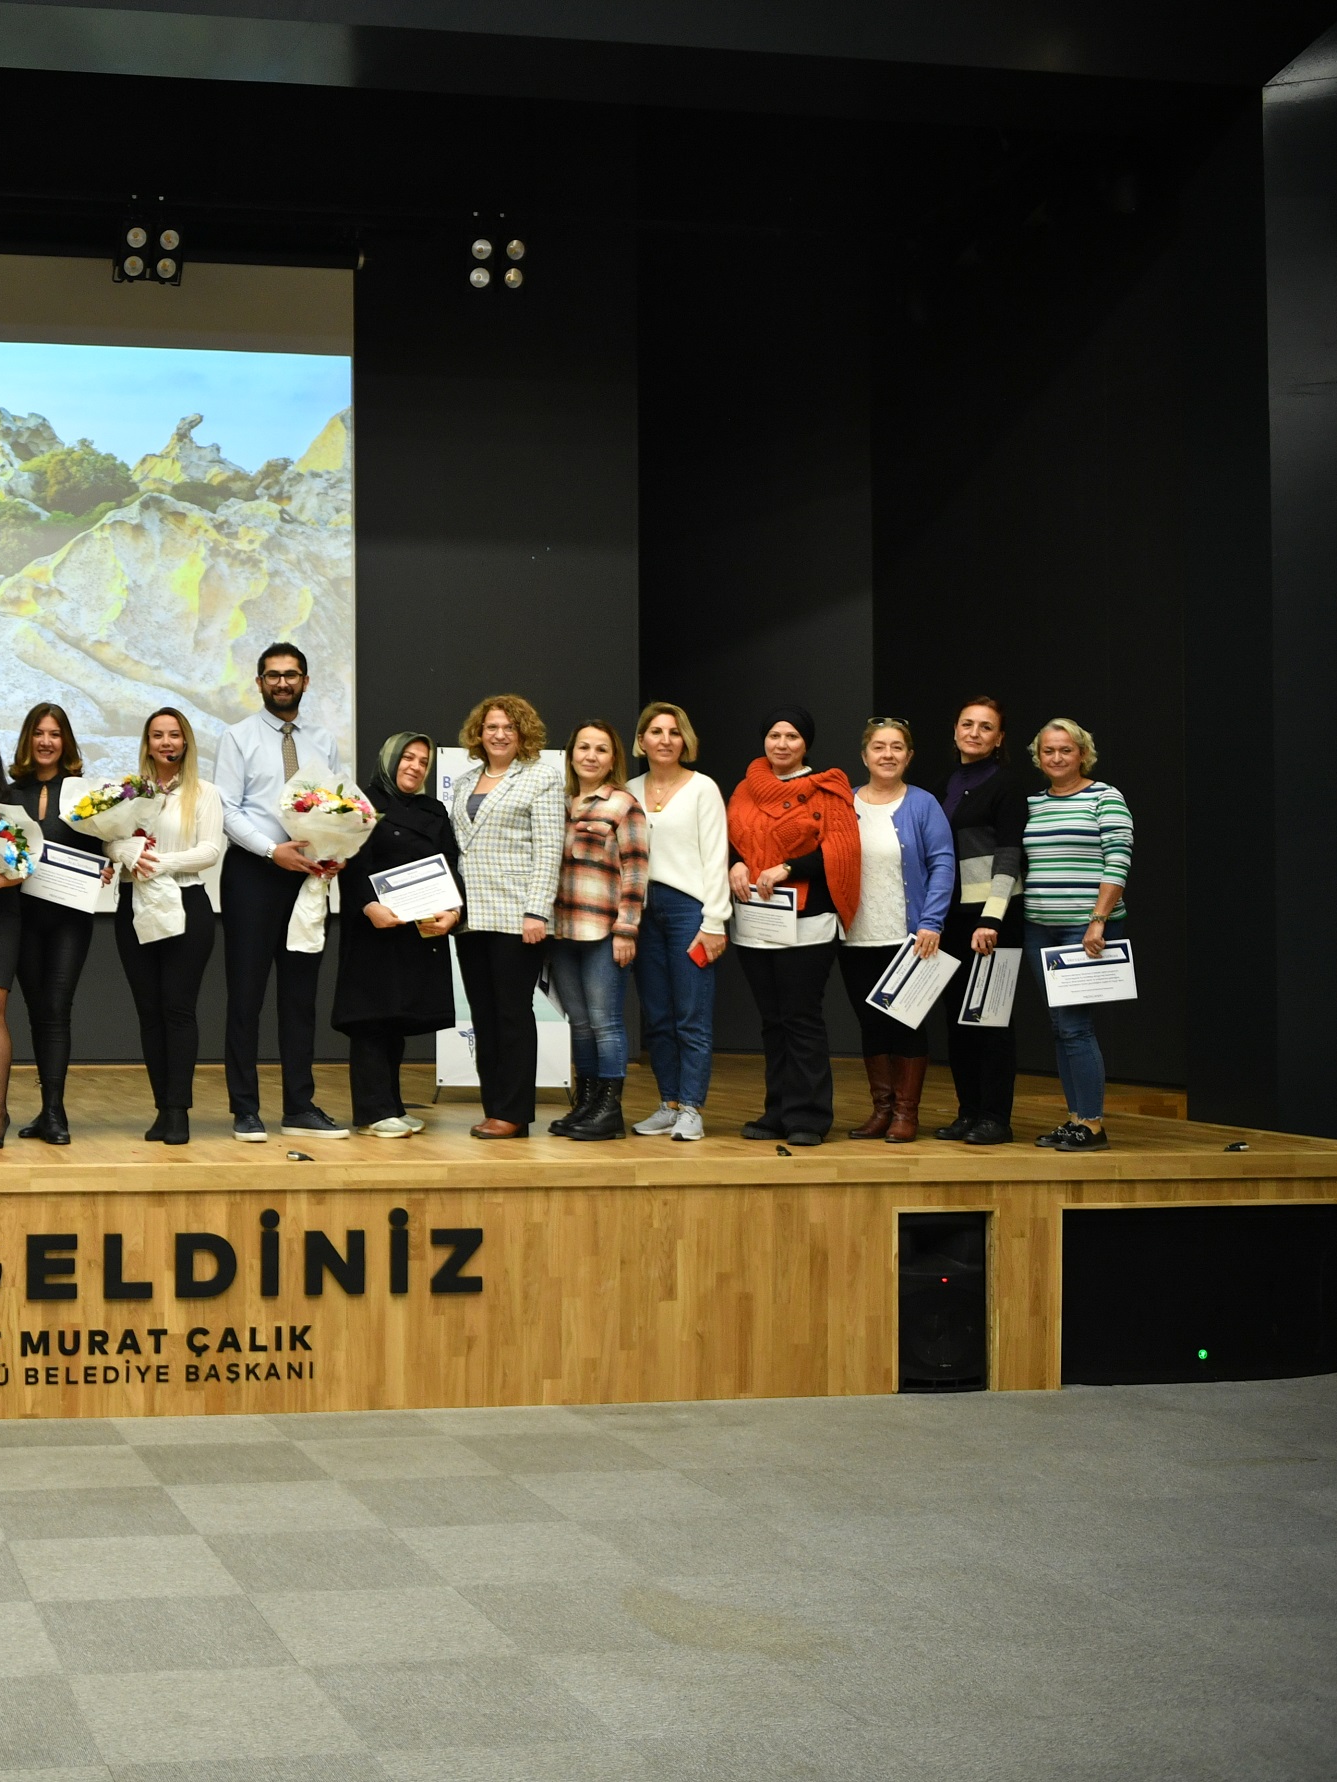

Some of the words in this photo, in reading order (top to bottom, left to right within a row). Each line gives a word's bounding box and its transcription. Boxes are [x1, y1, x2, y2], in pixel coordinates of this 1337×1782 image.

[19, 1328, 168, 1357] MURAT
[185, 1325, 313, 1358] ÇALIK
[24, 1359, 170, 1386] BELEDİYE
[184, 1361, 315, 1384] BAŞKANI
